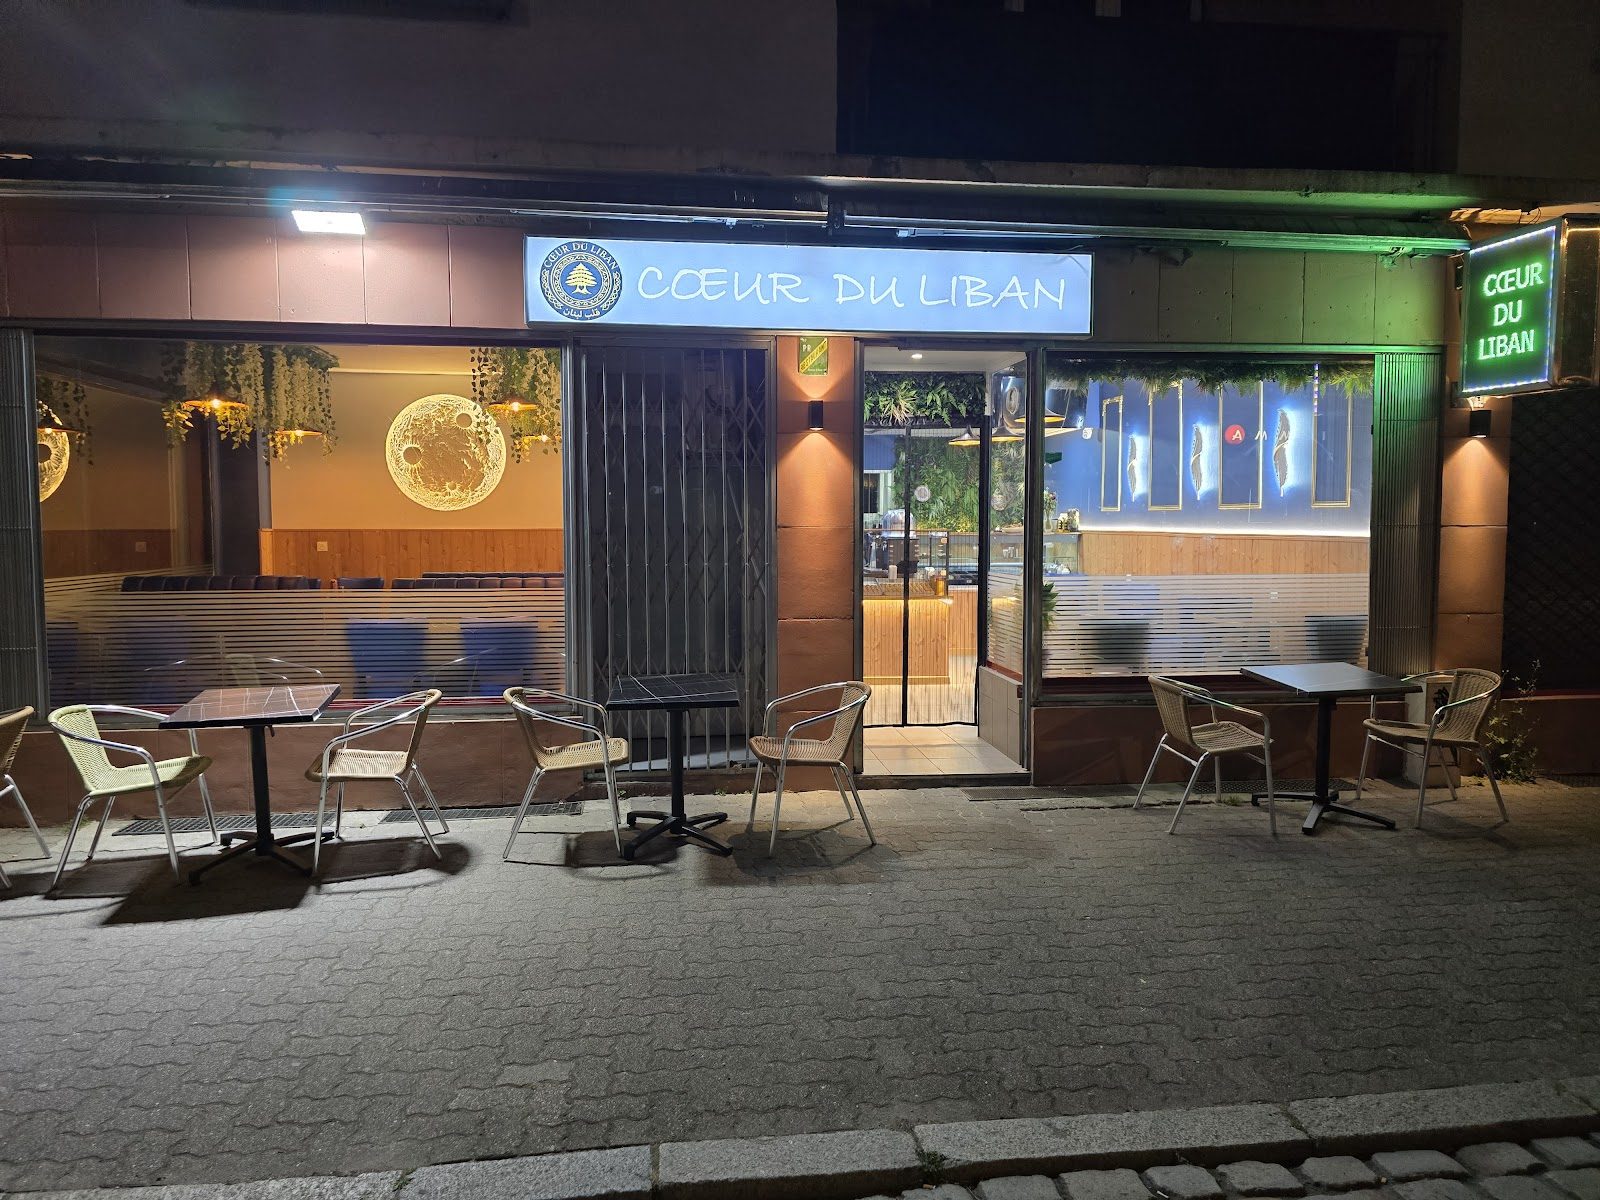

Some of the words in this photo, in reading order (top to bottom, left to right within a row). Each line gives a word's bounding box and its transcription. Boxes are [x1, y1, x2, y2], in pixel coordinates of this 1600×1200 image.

[572, 242, 588, 251] DU
[590, 245, 619, 270] LIBAN
[637, 266, 809, 305] CŒUR
[833, 272, 905, 308] DU
[919, 274, 1066, 311] LIBAN
[1482, 261, 1544, 297] CŒUR
[1492, 299, 1523, 327] DU
[1477, 329, 1536, 361] LIBAN
